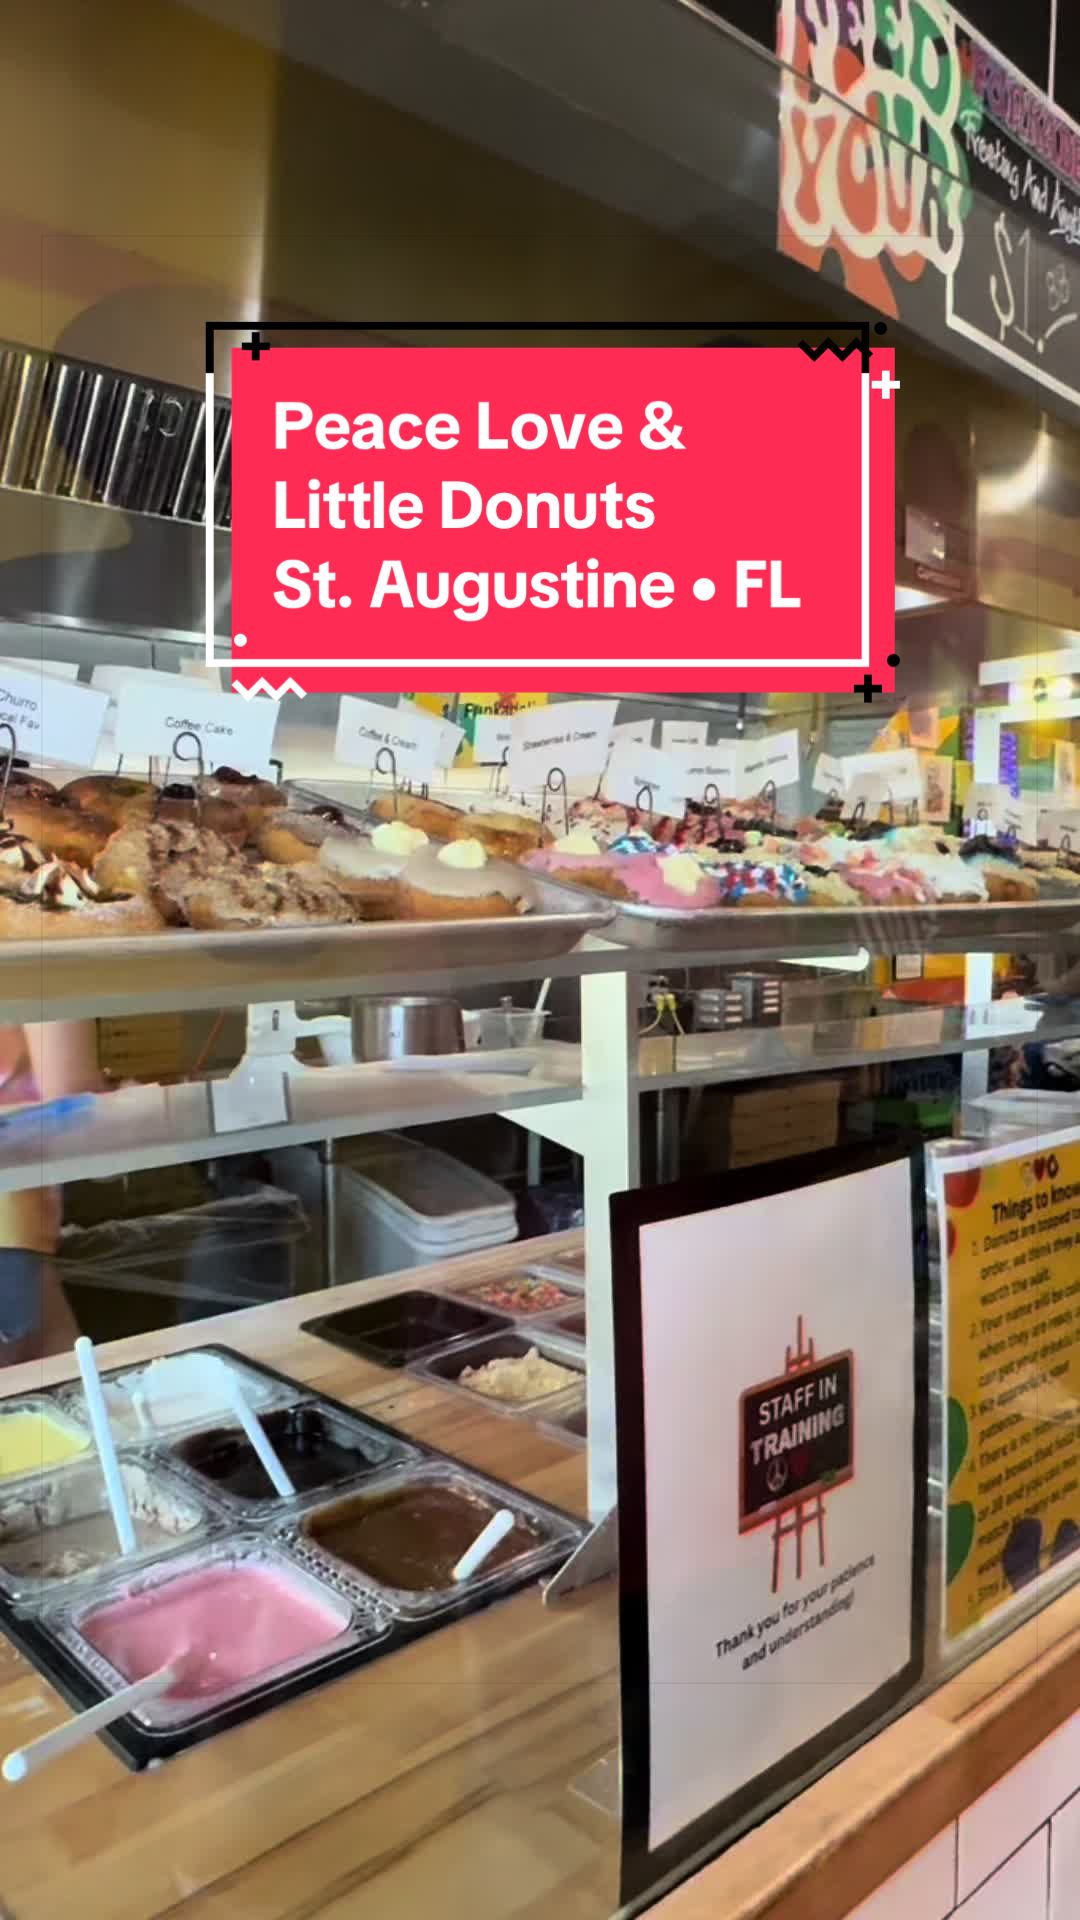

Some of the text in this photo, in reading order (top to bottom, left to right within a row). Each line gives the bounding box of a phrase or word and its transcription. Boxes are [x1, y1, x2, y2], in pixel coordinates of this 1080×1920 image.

[779, 88, 963, 273] YOUR
[165, 716, 234, 736] Coffee Cake
[991, 1197, 1032, 1224] Things
[1035, 1191, 1049, 1211] to
[759, 1373, 838, 1425] STAFF IN
[750, 1403, 844, 1465] TRAINING
[715, 1553, 875, 1658] Thank you for your patience
[742, 1587, 855, 1671] and understanding!
